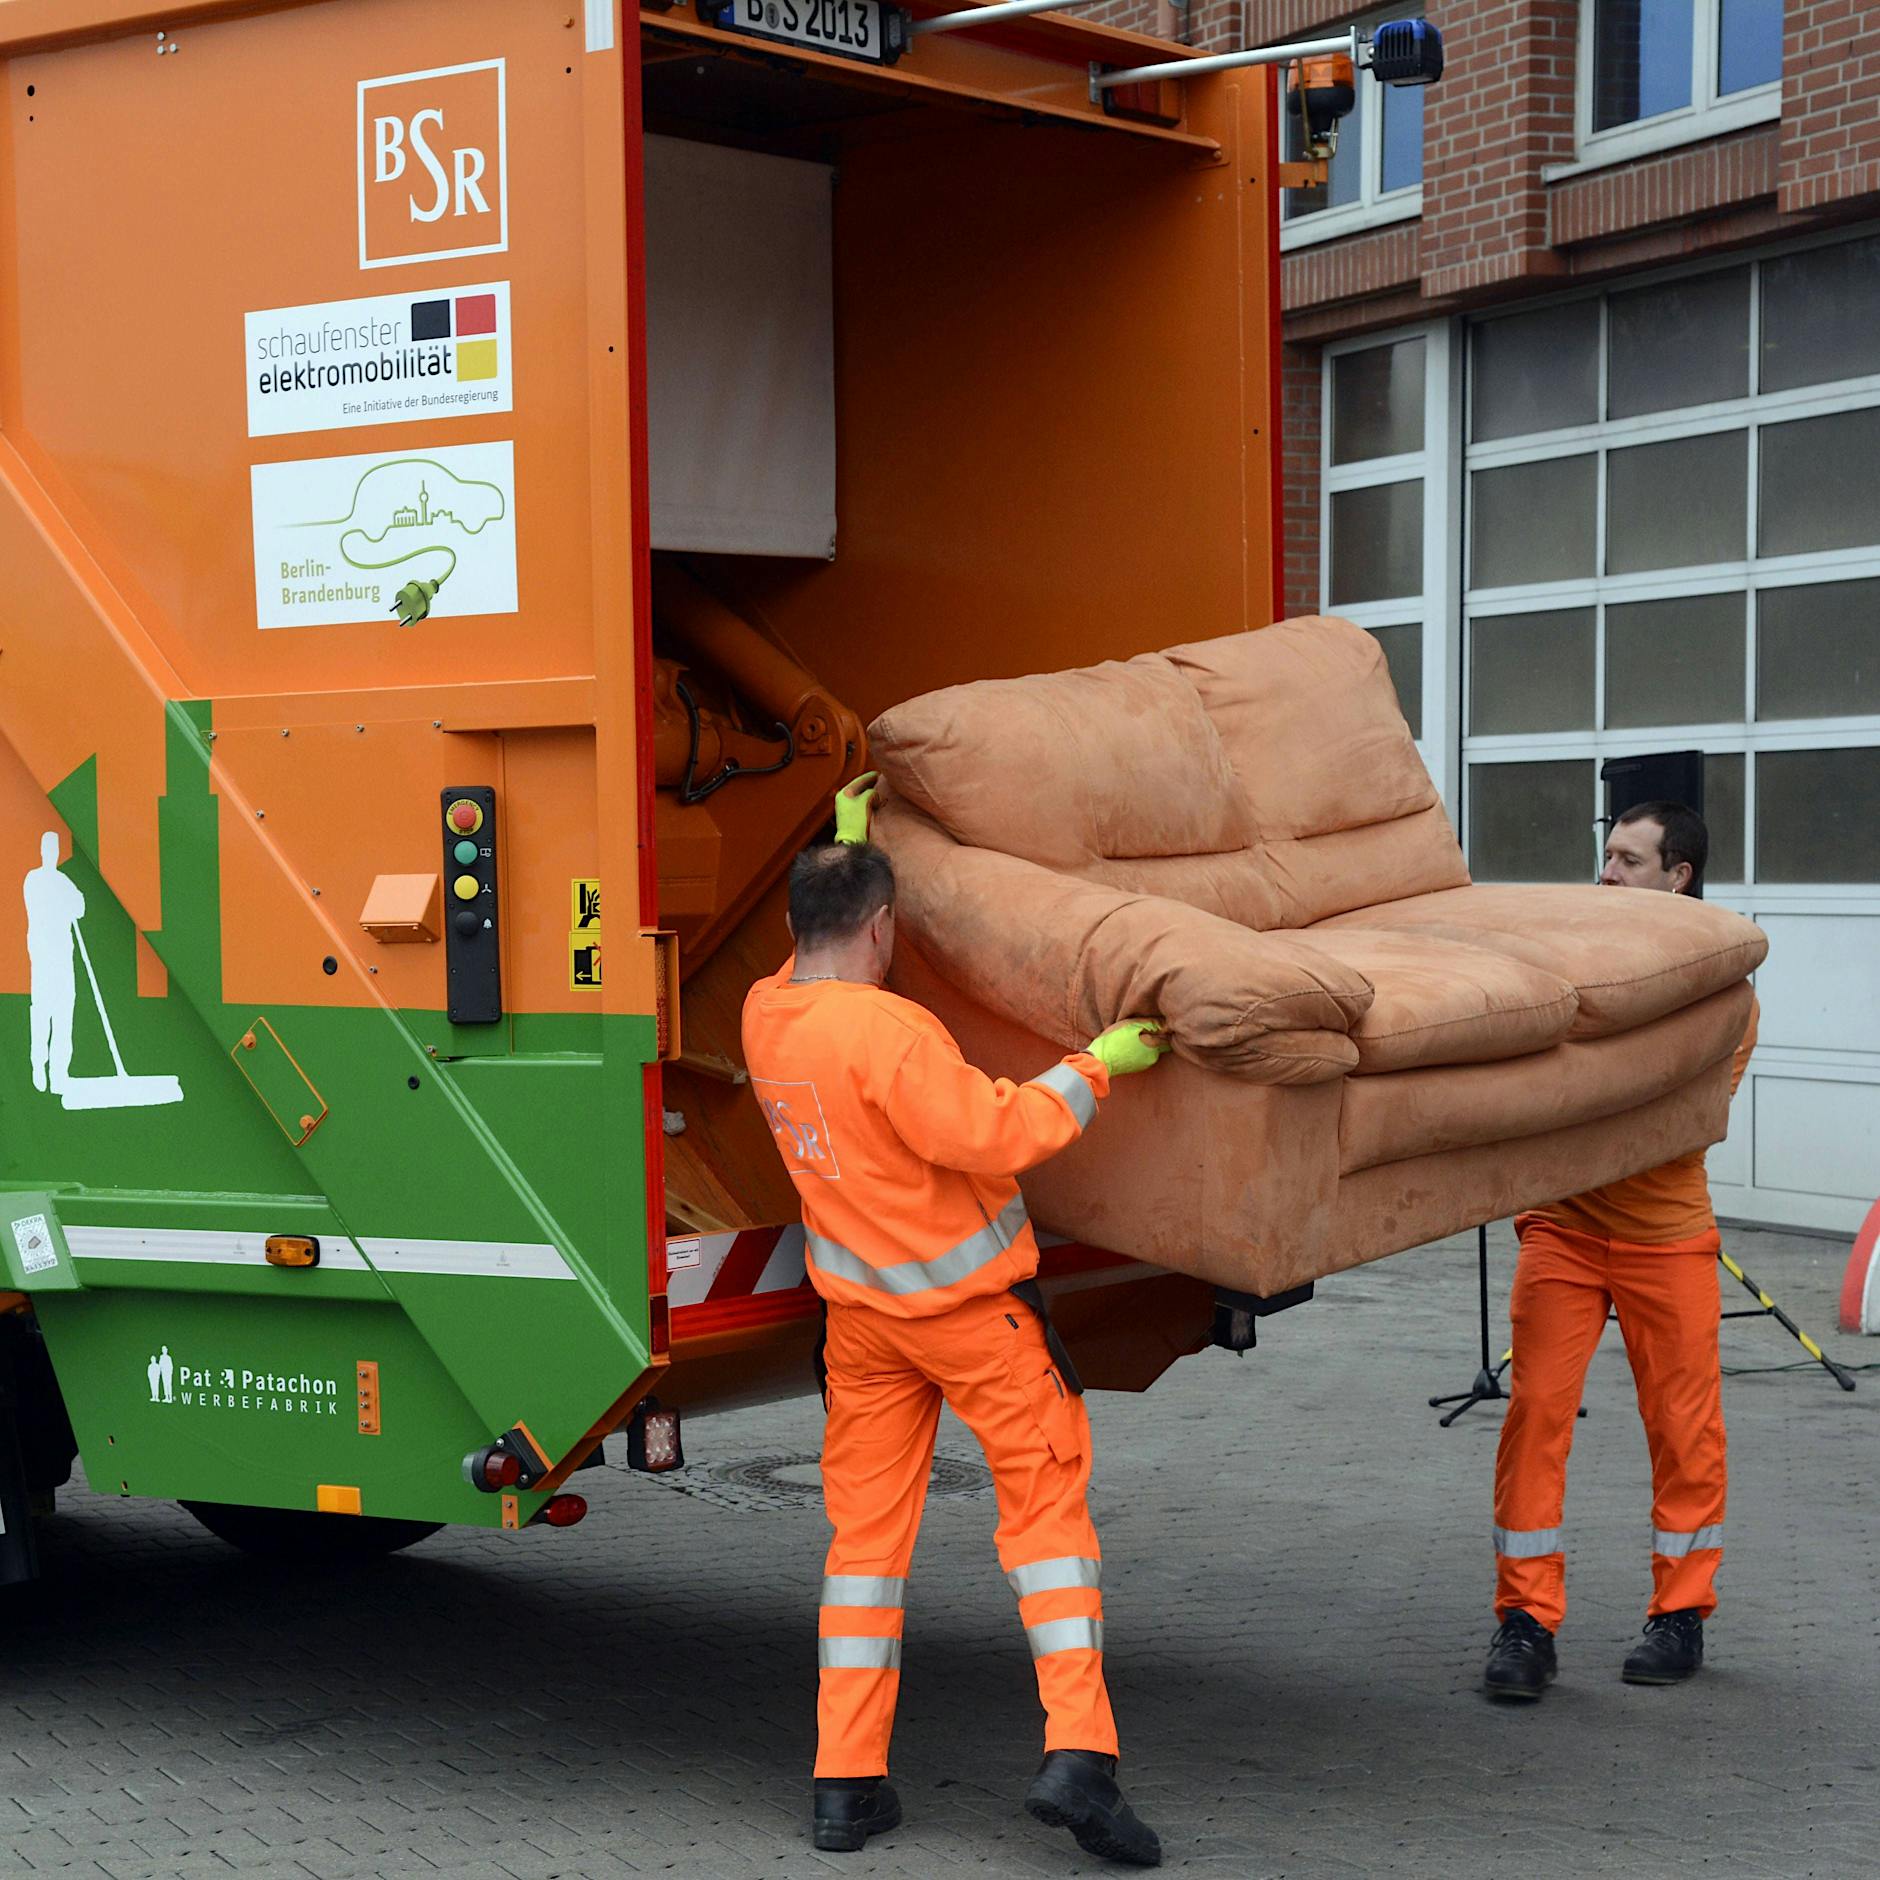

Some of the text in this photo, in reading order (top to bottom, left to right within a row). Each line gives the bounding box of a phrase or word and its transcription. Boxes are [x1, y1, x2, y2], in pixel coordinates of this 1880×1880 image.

[805, 0, 869, 48] 2013
[373, 108, 491, 223] BSR
[258, 316, 402, 360] schaufenster
[259, 344, 452, 394] elektromobilität
[343, 390, 499, 414] Eine Initiative der Bundesregierung
[281, 559, 332, 579] Berlin-
[282, 582, 381, 605] Brandenburg
[448, 800, 480, 816] EMERGENCY
[180, 1367, 211, 1387] Pat
[242, 1370, 337, 1395] Patachon
[181, 1392, 337, 1415] WERBEFABRIK
